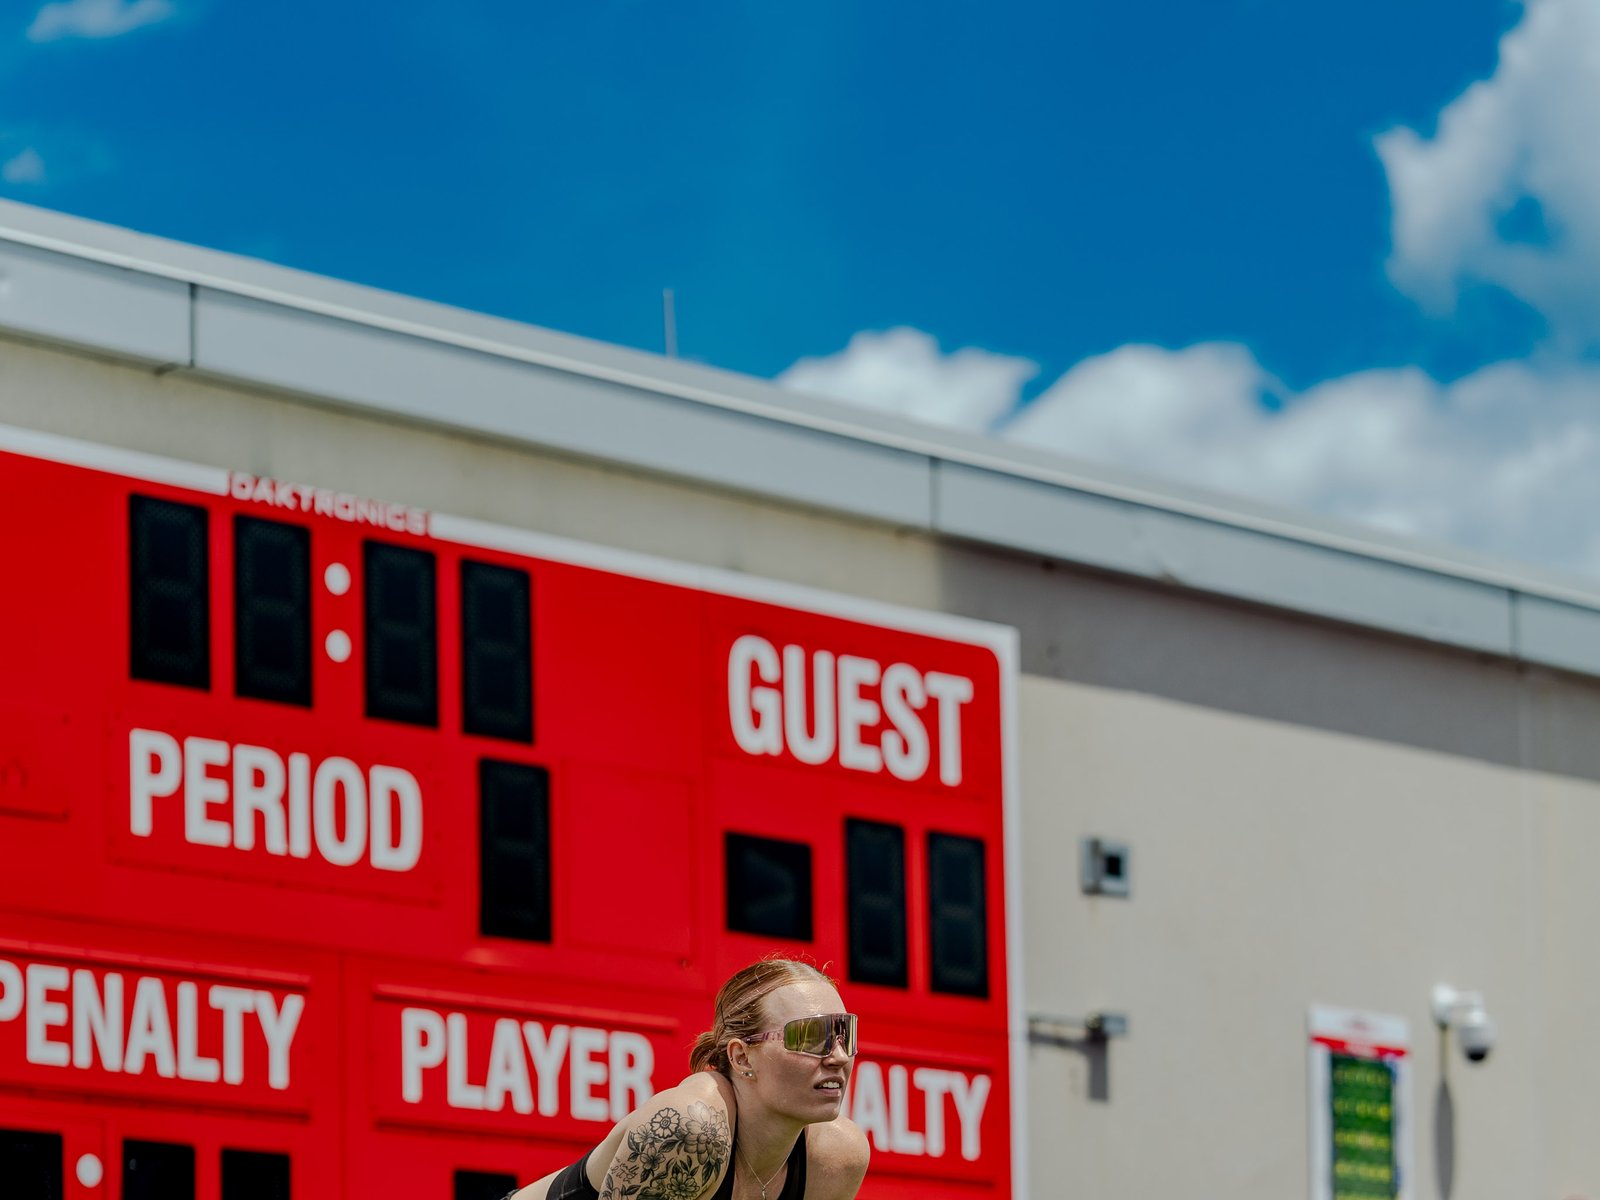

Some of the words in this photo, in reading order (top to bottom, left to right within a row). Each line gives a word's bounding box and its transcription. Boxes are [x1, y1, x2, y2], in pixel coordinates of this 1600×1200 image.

[727, 634, 974, 787] GUEST
[129, 728, 423, 872] PERIOD
[401, 1007, 655, 1124] PLAYER
[841, 1061, 991, 1162] ALTY
